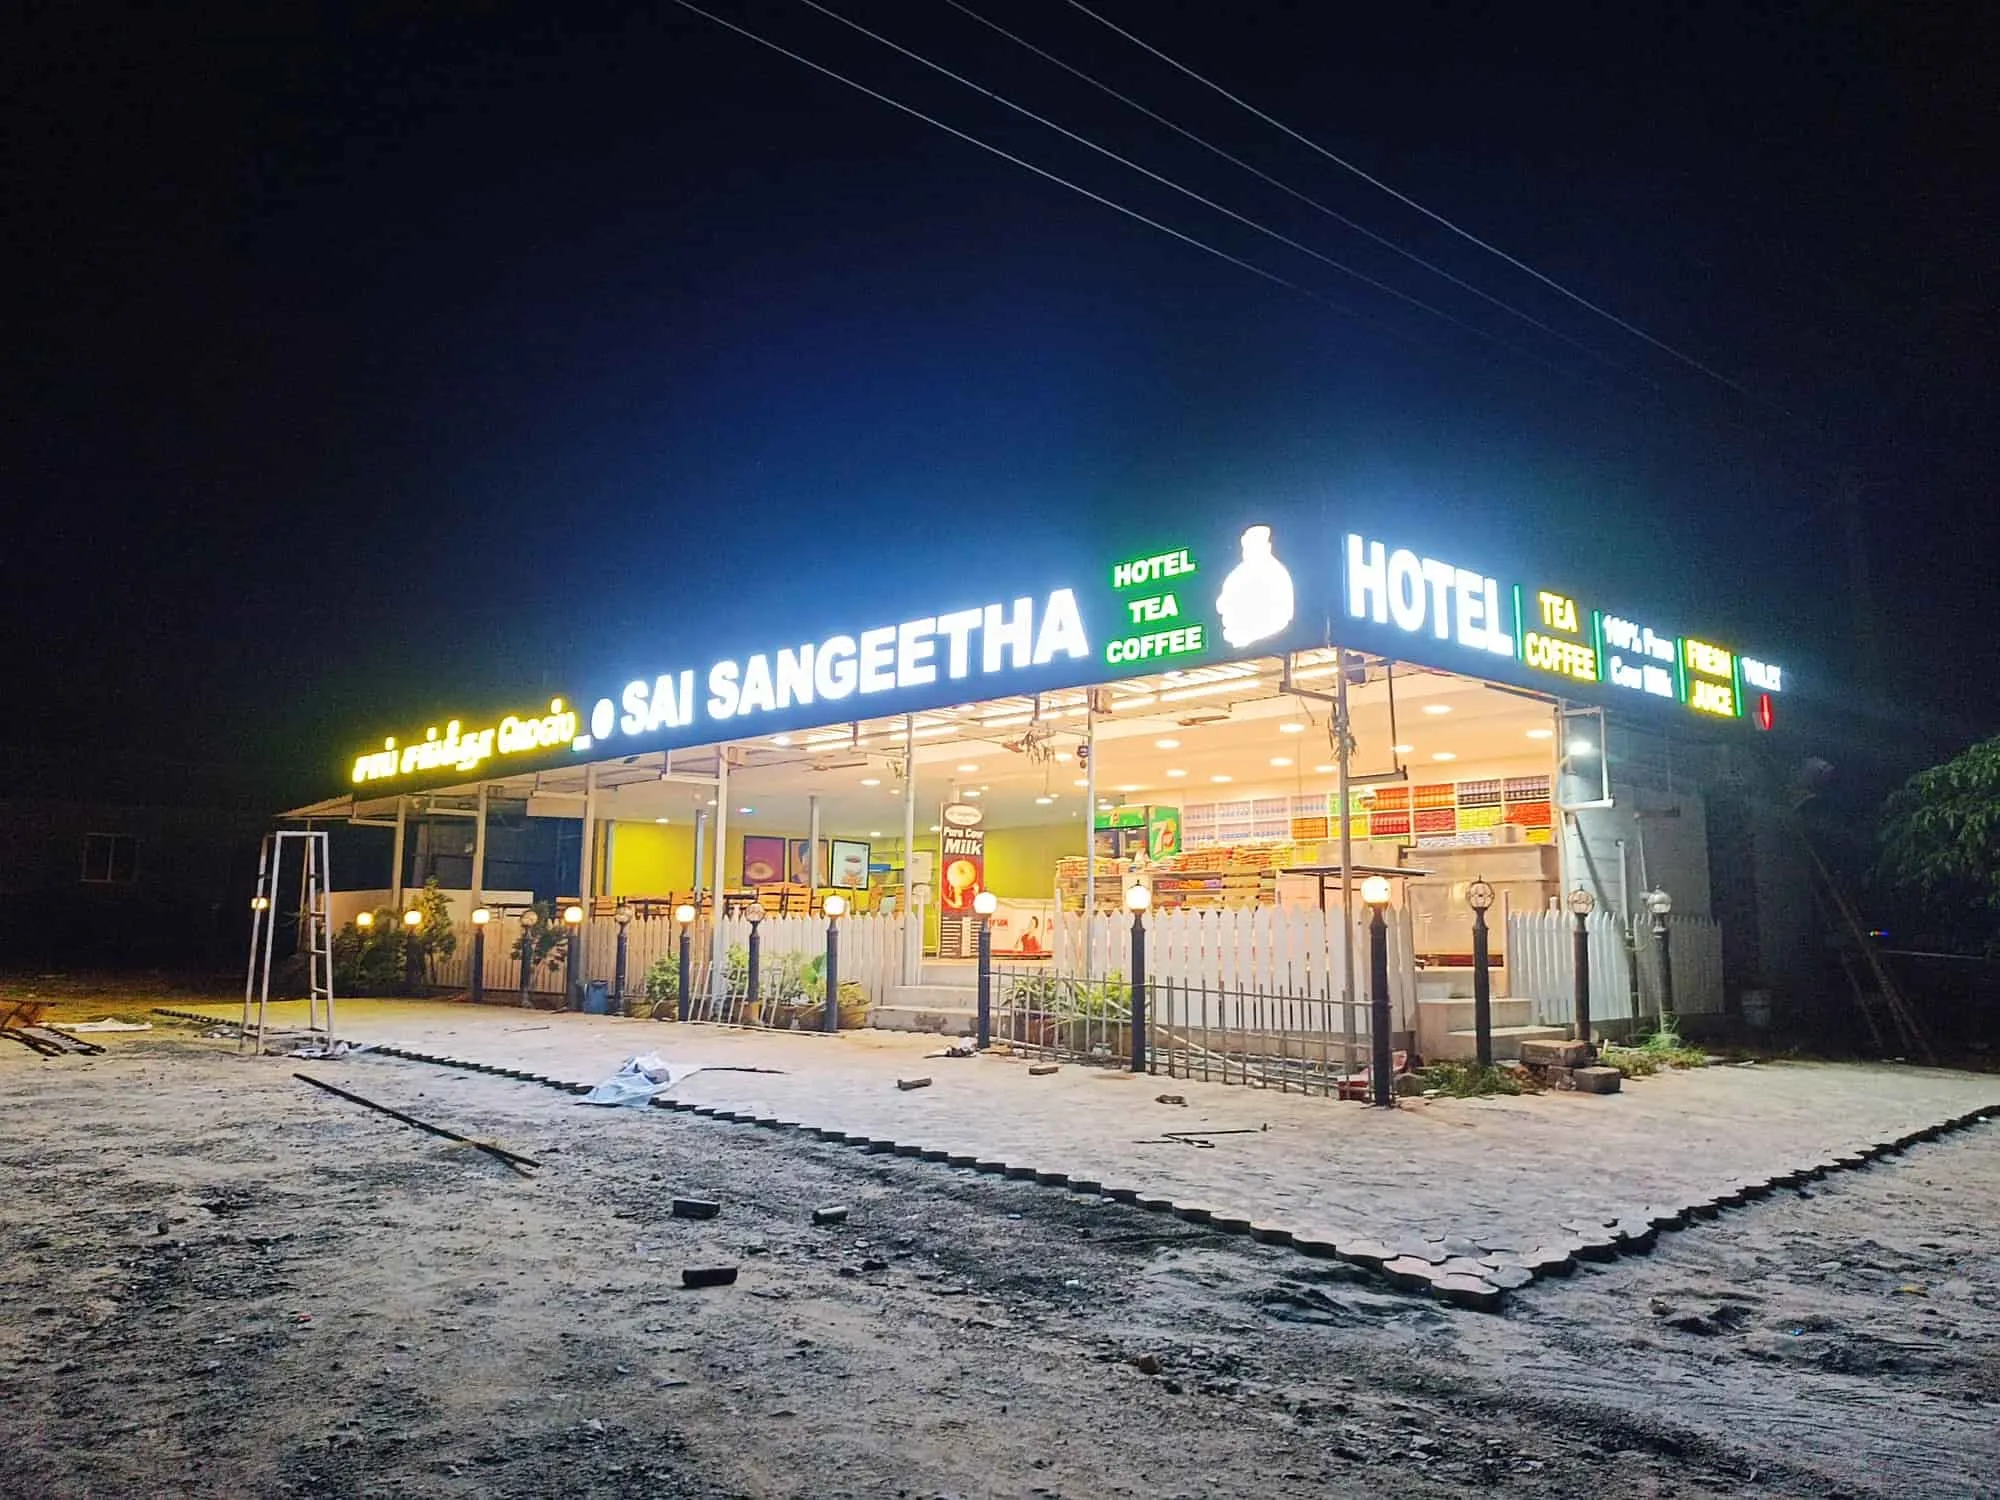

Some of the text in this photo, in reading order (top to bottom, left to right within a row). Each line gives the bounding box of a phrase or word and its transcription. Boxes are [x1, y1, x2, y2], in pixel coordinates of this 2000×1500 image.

[1115, 550, 1196, 588] HOTEL
[1128, 594, 1179, 623] TEA
[1346, 533, 1514, 656] HOTEL
[1539, 591, 1579, 633] TEA
[621, 588, 1090, 735] SAI SANGEETHA
[1106, 625, 1203, 664] COFFEE
[1525, 632, 1596, 681] COFFEE
[1686, 639, 1732, 679] FRESH
[1693, 679, 1735, 717] JUICE
[944, 838, 983, 855] Milk
